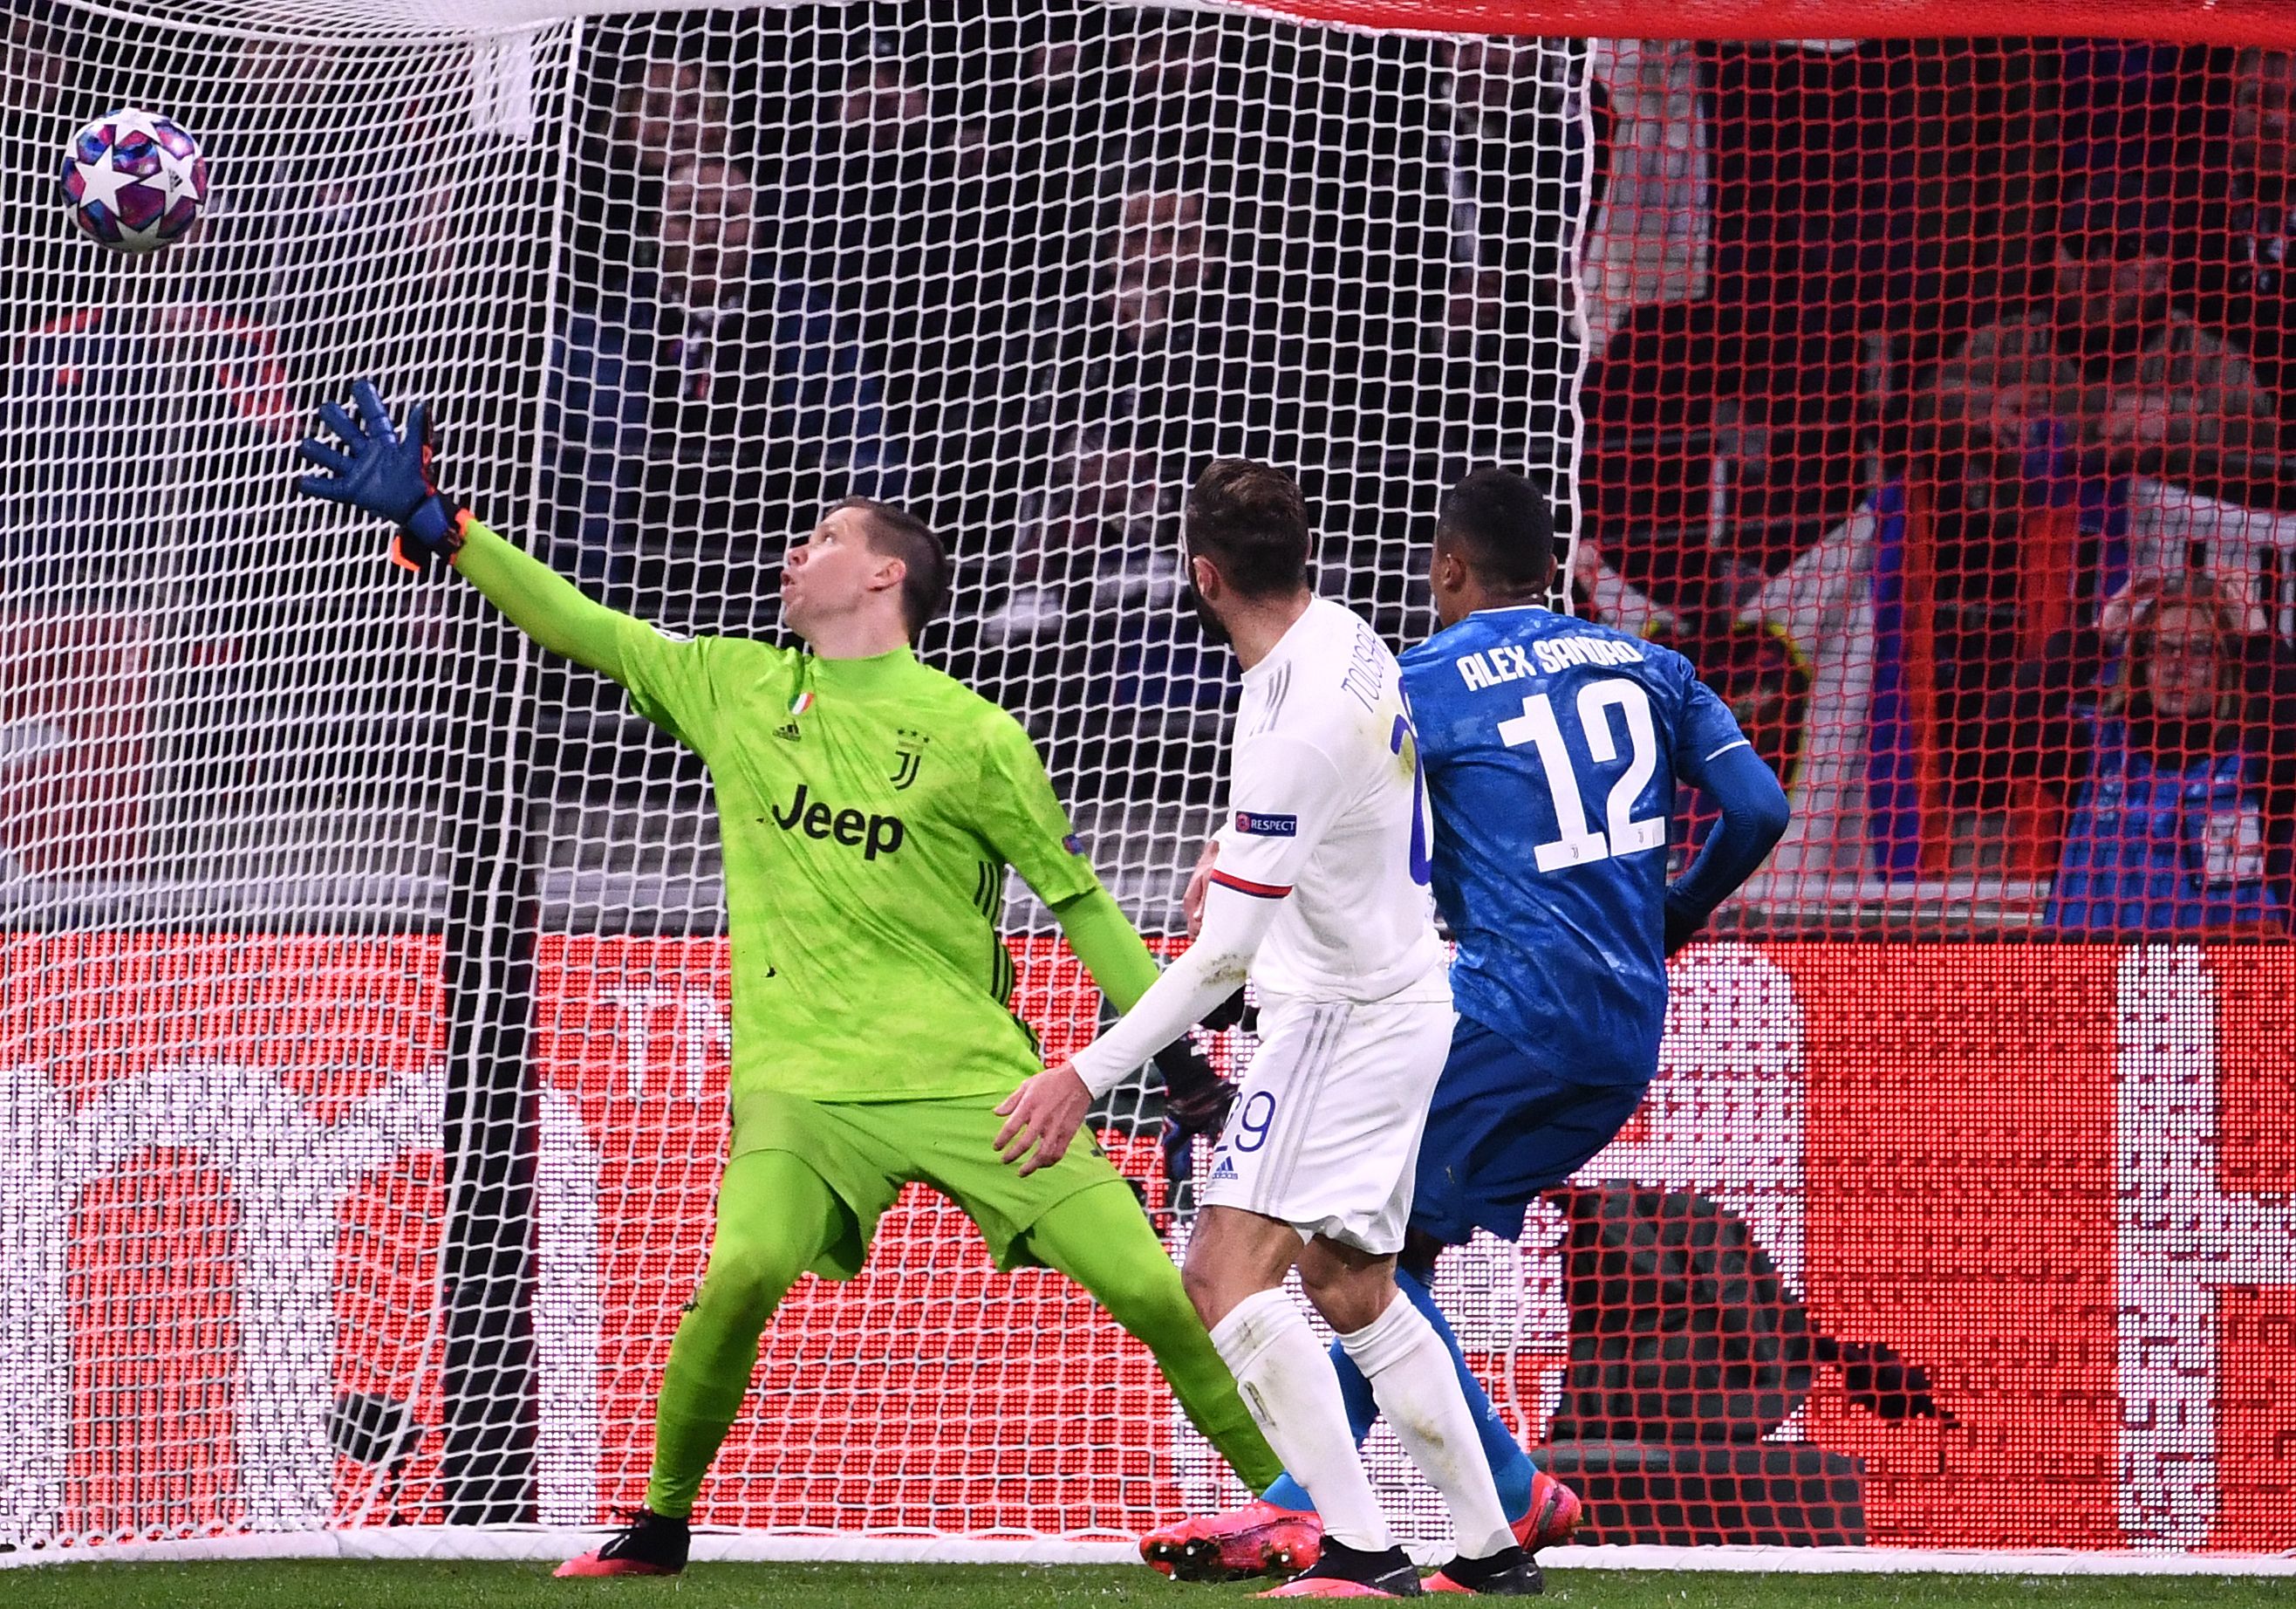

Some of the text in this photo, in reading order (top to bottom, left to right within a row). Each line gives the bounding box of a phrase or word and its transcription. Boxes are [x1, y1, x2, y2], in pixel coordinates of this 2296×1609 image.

[1456, 636, 1644, 692] ALEX SANDRO
[1497, 678, 1666, 873] 12
[771, 784, 905, 862] Jeep
[1250, 818, 1295, 832] RESPECT
